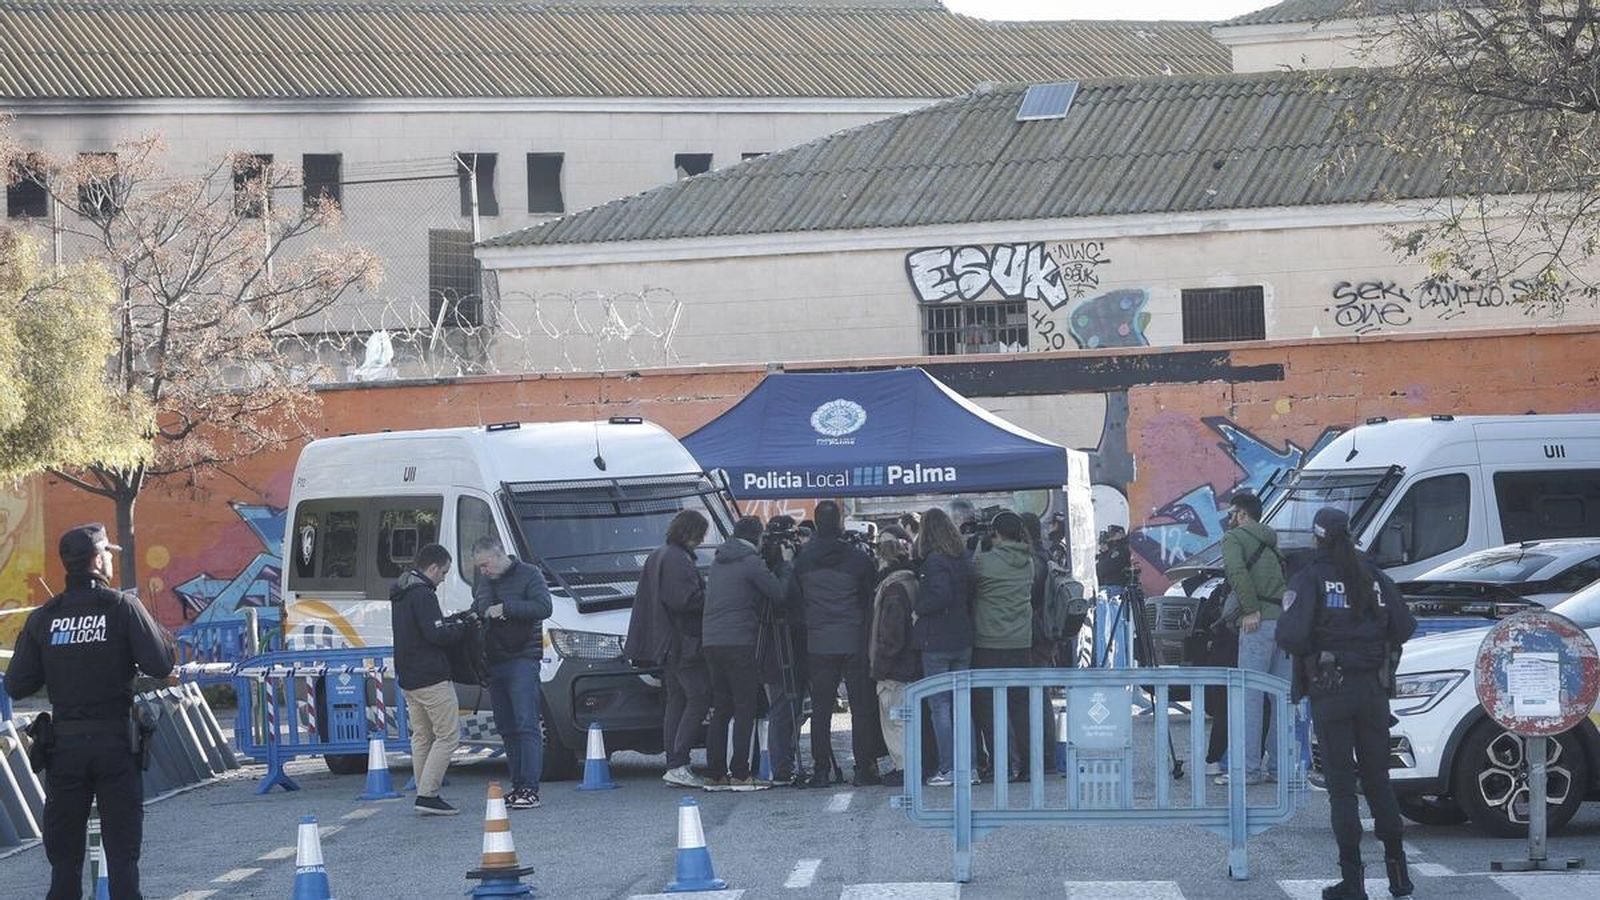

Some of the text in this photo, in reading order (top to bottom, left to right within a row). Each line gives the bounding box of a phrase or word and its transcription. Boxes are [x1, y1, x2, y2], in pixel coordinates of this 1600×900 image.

[743, 463, 957, 490] Policia Local Palma
[50, 614, 107, 632] POLICIA
[70, 628, 107, 644] LOCAL
